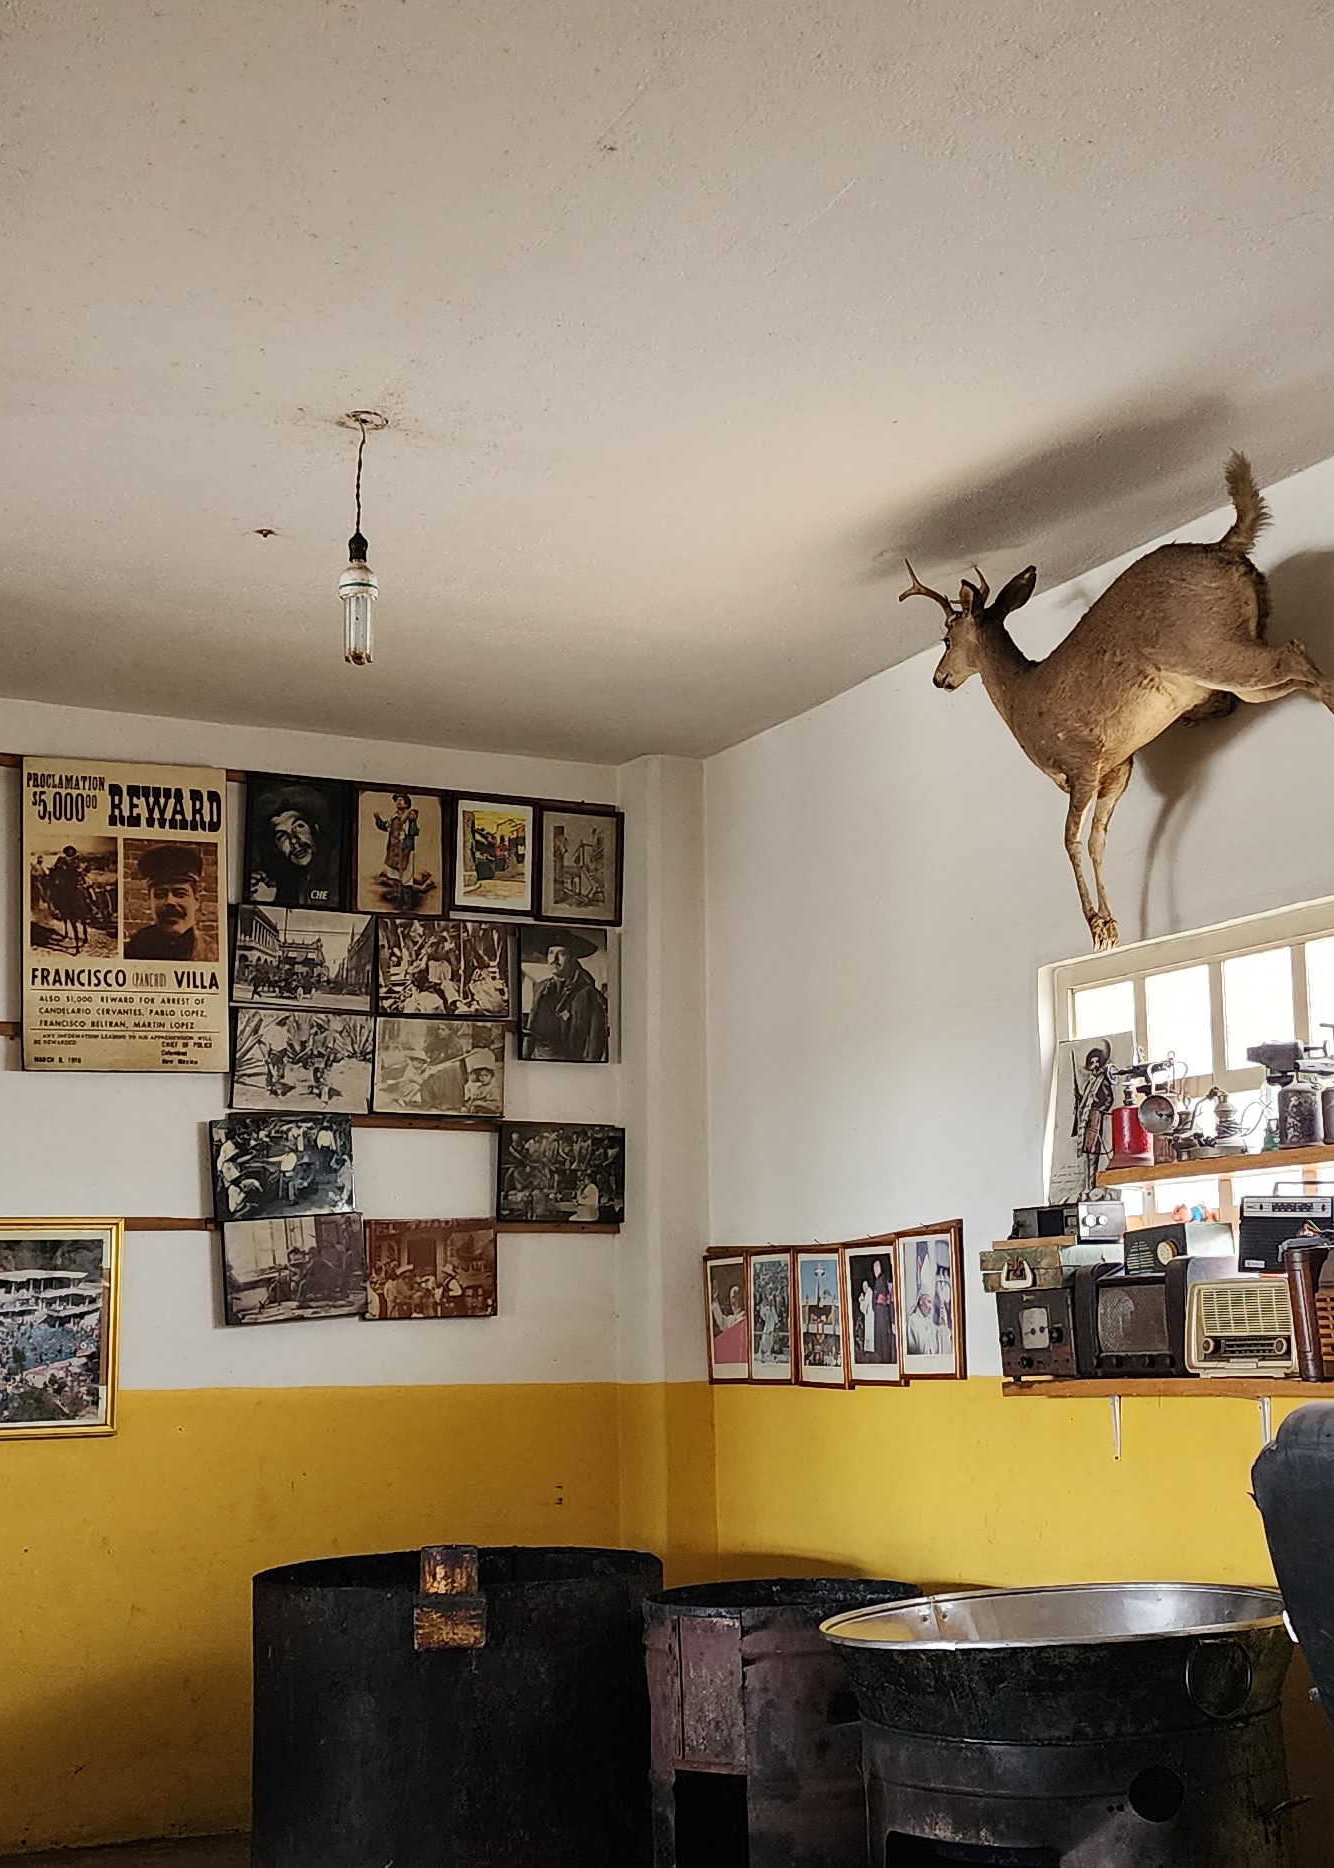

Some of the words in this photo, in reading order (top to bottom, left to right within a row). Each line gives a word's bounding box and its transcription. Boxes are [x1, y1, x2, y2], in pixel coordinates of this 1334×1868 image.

[26, 771, 105, 791] PROCLAMATION
[108, 784, 222, 832] REWARD
[310, 889, 328, 900] CHE
[31, 968, 126, 987] FRANCISCO
[132, 972, 167, 988] (PANCHO)
[174, 970, 219, 989] VILLA
[39, 995, 60, 1003] ALSO
[100, 996, 135, 1004] REWARD
[160, 997, 190, 1005] ARREST
[39, 1006, 91, 1015] CANDELARIO
[149, 1008, 176, 1017] PABLO
[39, 1019, 86, 1028] FRANCISCO
[133, 1020, 166, 1029] MARTIN
[169, 1021, 195, 1029] LOPEZ
